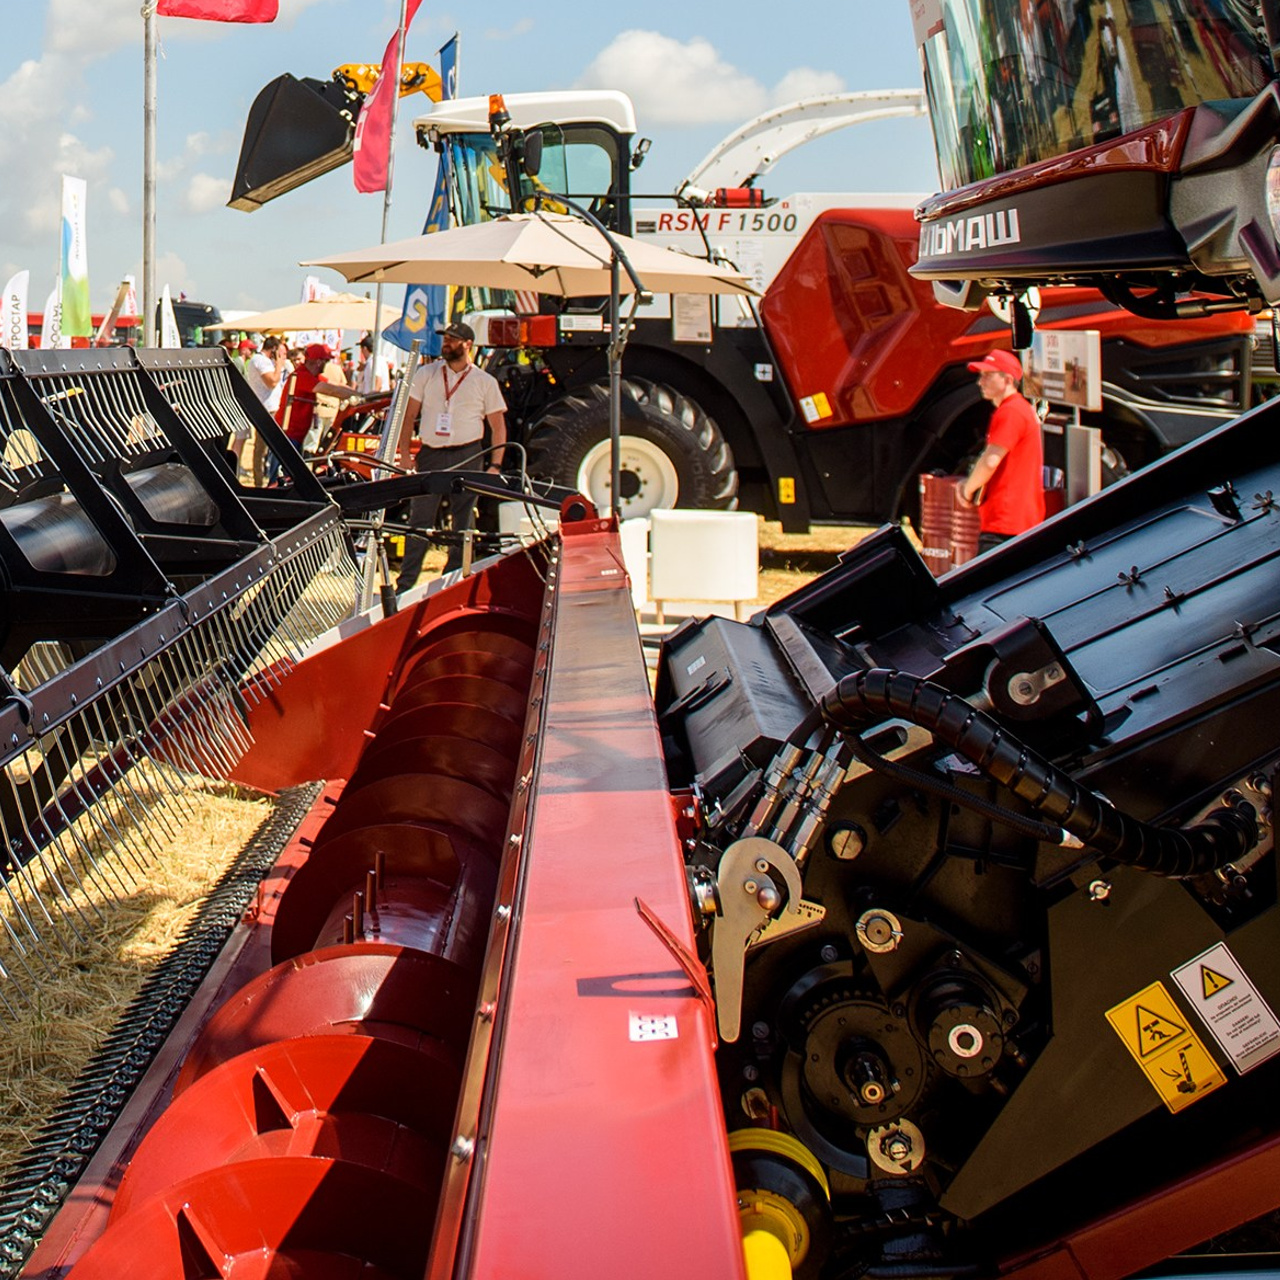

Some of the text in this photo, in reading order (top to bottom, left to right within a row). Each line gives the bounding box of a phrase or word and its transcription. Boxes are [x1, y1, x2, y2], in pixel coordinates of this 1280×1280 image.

[658, 213, 710, 231] RSM
[718, 213, 731, 231] F
[739, 213, 797, 232] 1500
